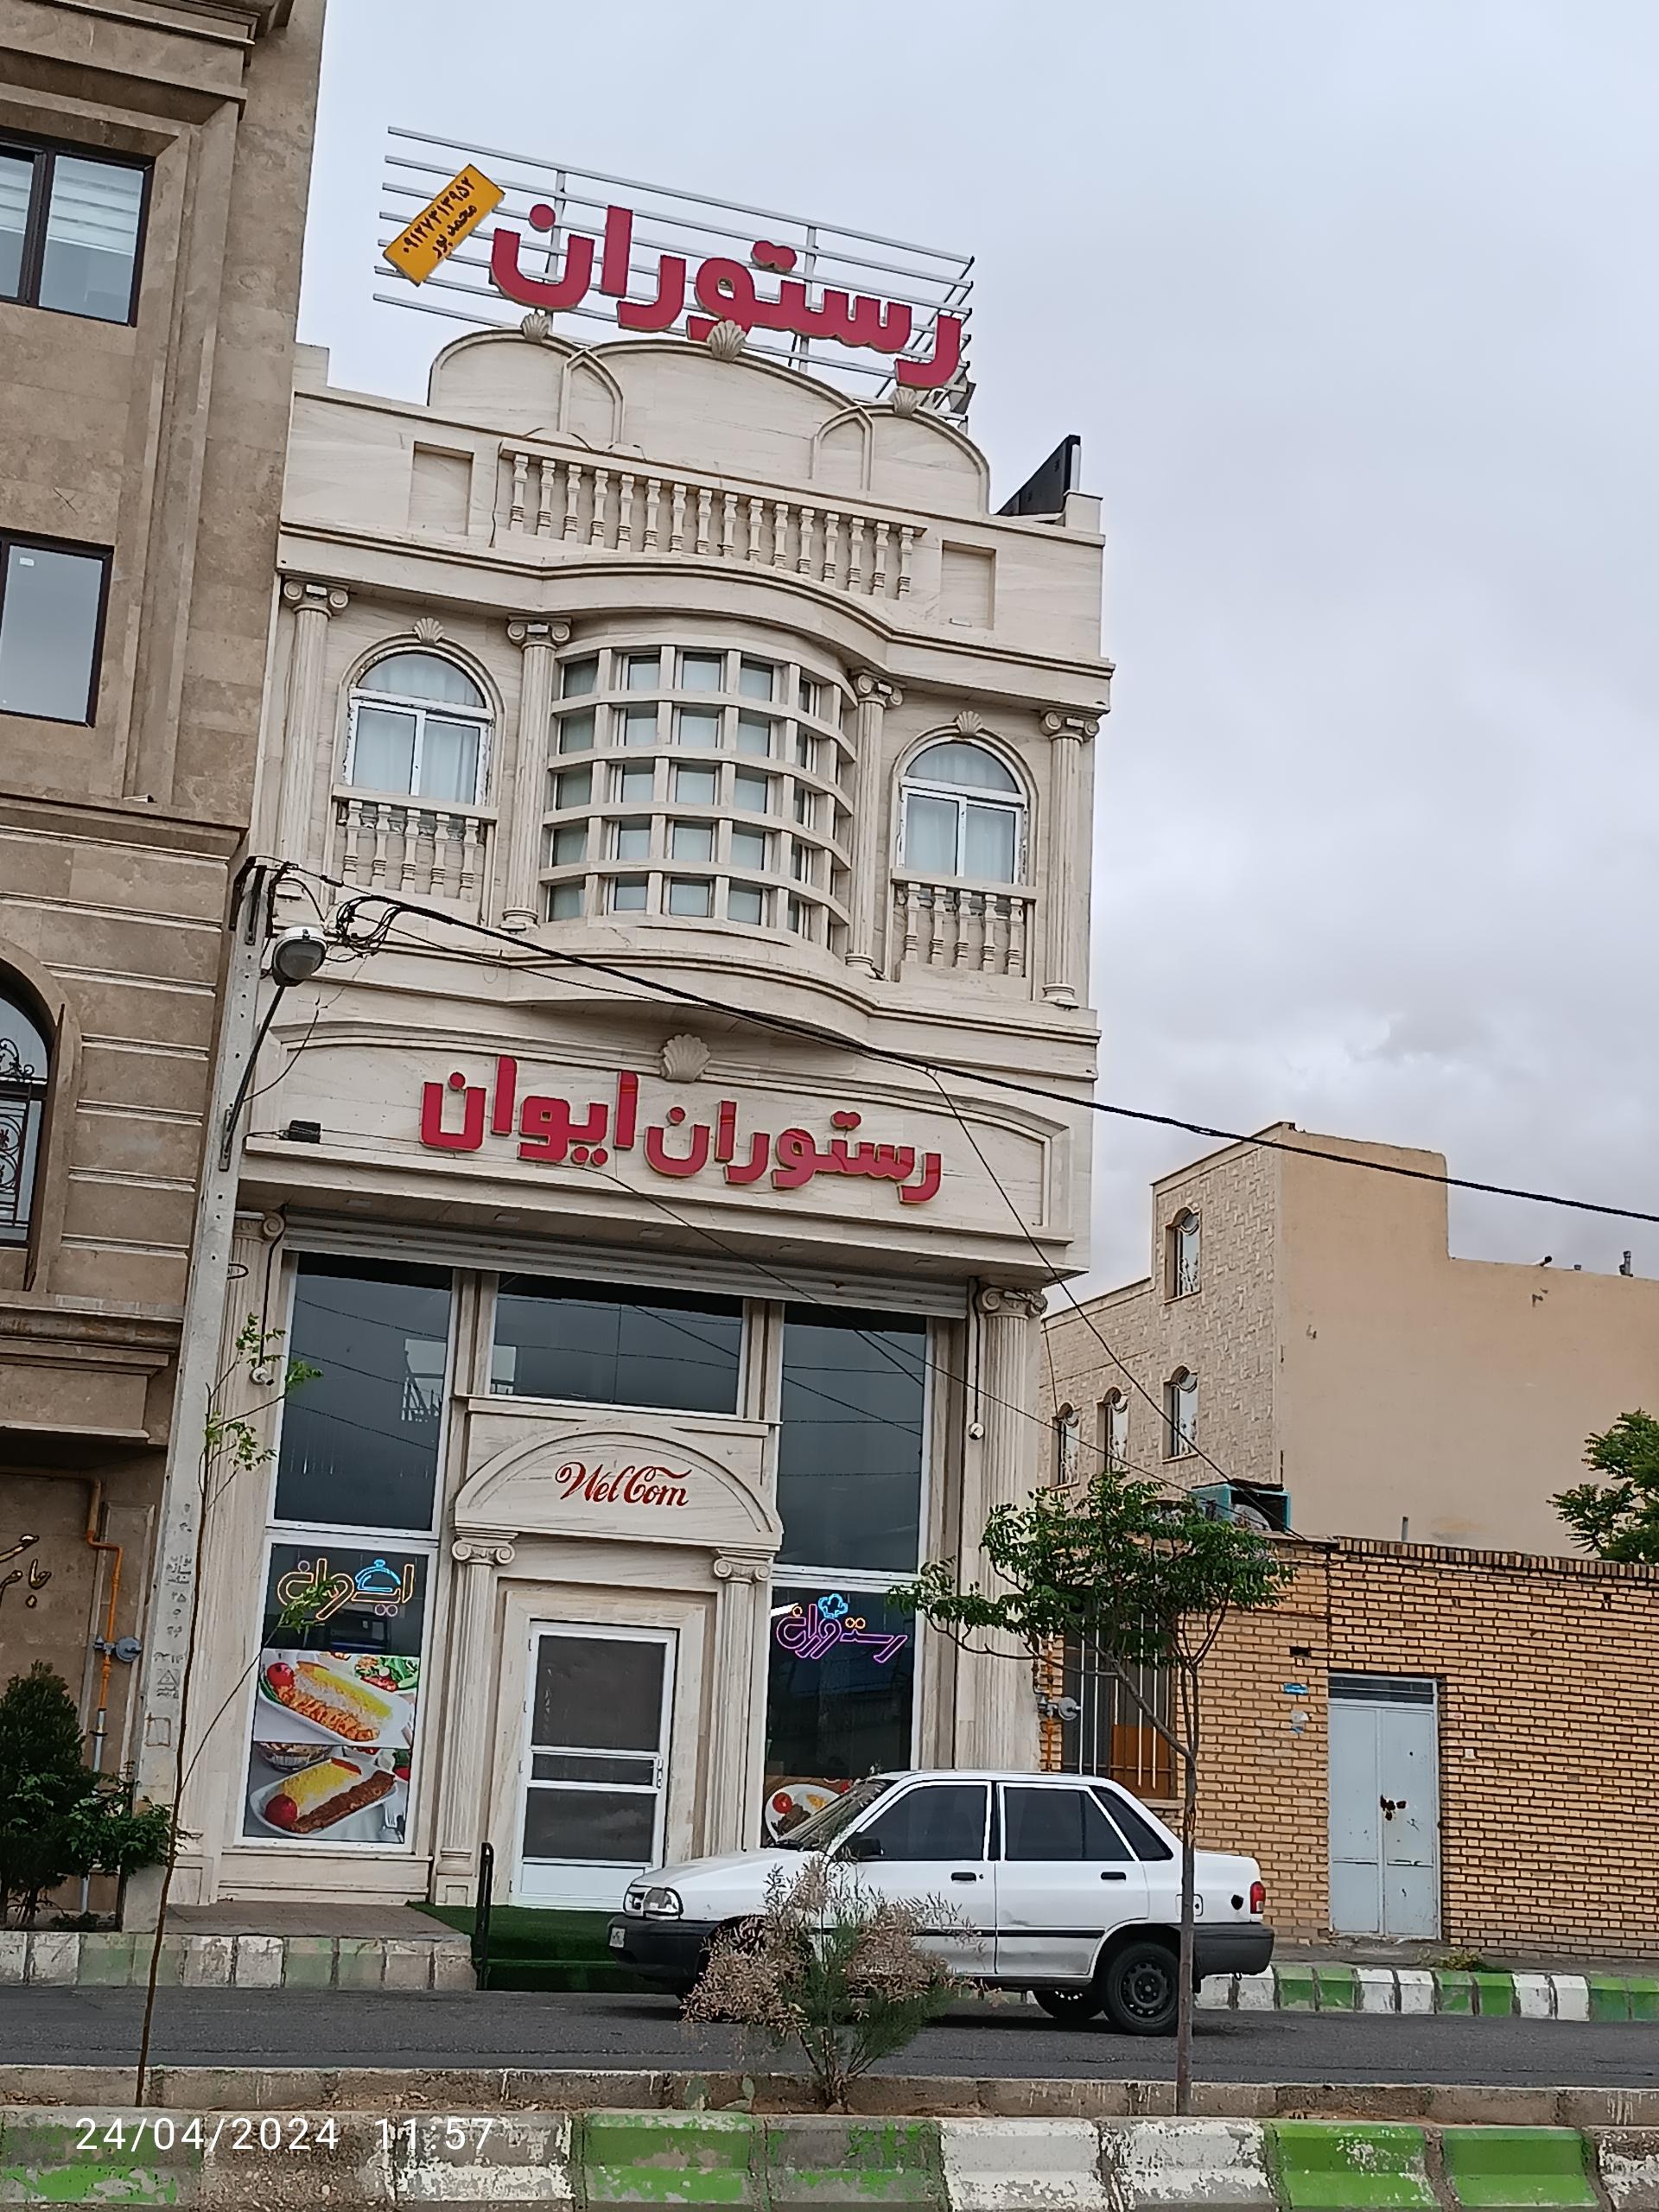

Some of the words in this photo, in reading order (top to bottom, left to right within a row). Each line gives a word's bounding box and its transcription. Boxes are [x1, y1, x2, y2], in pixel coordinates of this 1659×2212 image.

[447, 205, 477, 237] محمد
[489, 204, 961, 388] رستوران
[420, 1056, 639, 1166] ایوان
[644, 1100, 942, 1204] رستوران
[276, 1558, 415, 1621] ایوان
[776, 1604, 908, 1663] رستوران
